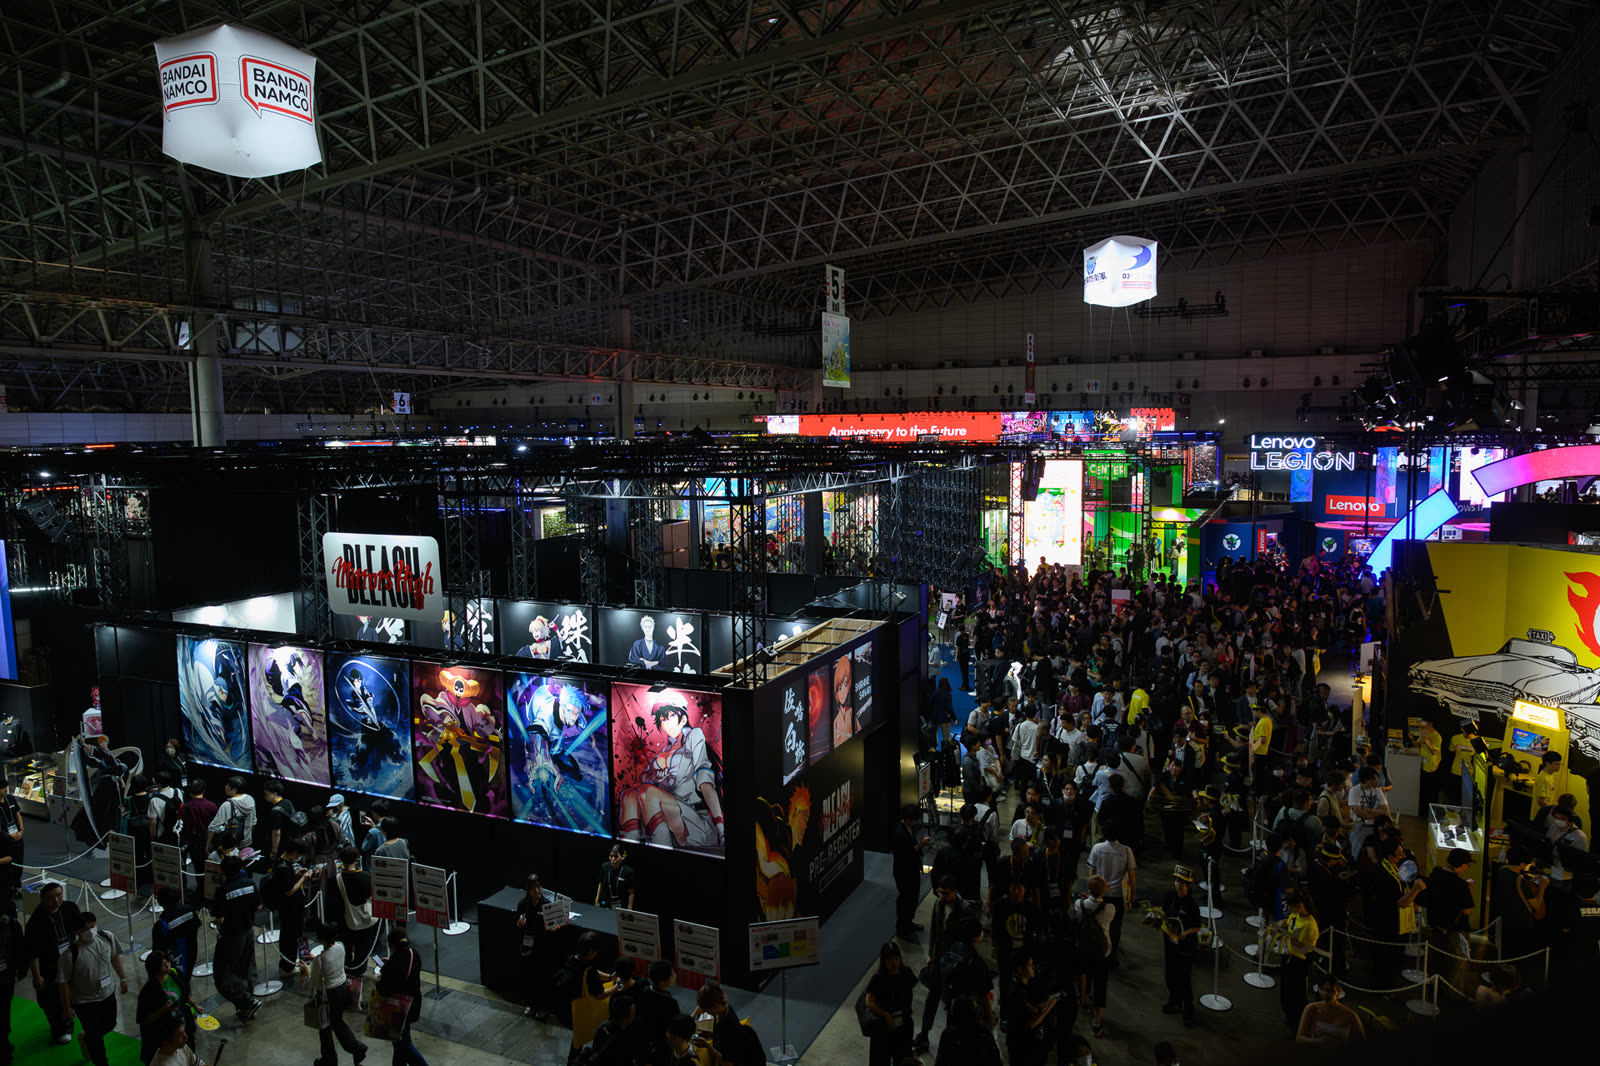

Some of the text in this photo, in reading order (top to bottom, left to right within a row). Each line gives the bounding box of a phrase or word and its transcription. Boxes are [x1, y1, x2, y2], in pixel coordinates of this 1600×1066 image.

[162, 63, 205, 85] BANDAI
[253, 68, 308, 97] BANDAI
[163, 80, 207, 101] NAMCO
[254, 84, 309, 112] NAMCO
[831, 269, 840, 300] 5
[399, 394, 405, 407] 6
[1131, 408, 1173, 416] KONAMI
[829, 425, 967, 439] Anniversary to the Future
[1251, 435, 1316, 449] Lenovo
[1251, 452, 1355, 471] LEGION
[1329, 499, 1380, 512] Lenovo
[332, 556, 434, 610] Mirrors High
[343, 544, 425, 609] BLEACH
[1532, 631, 1548, 640] TAXI
